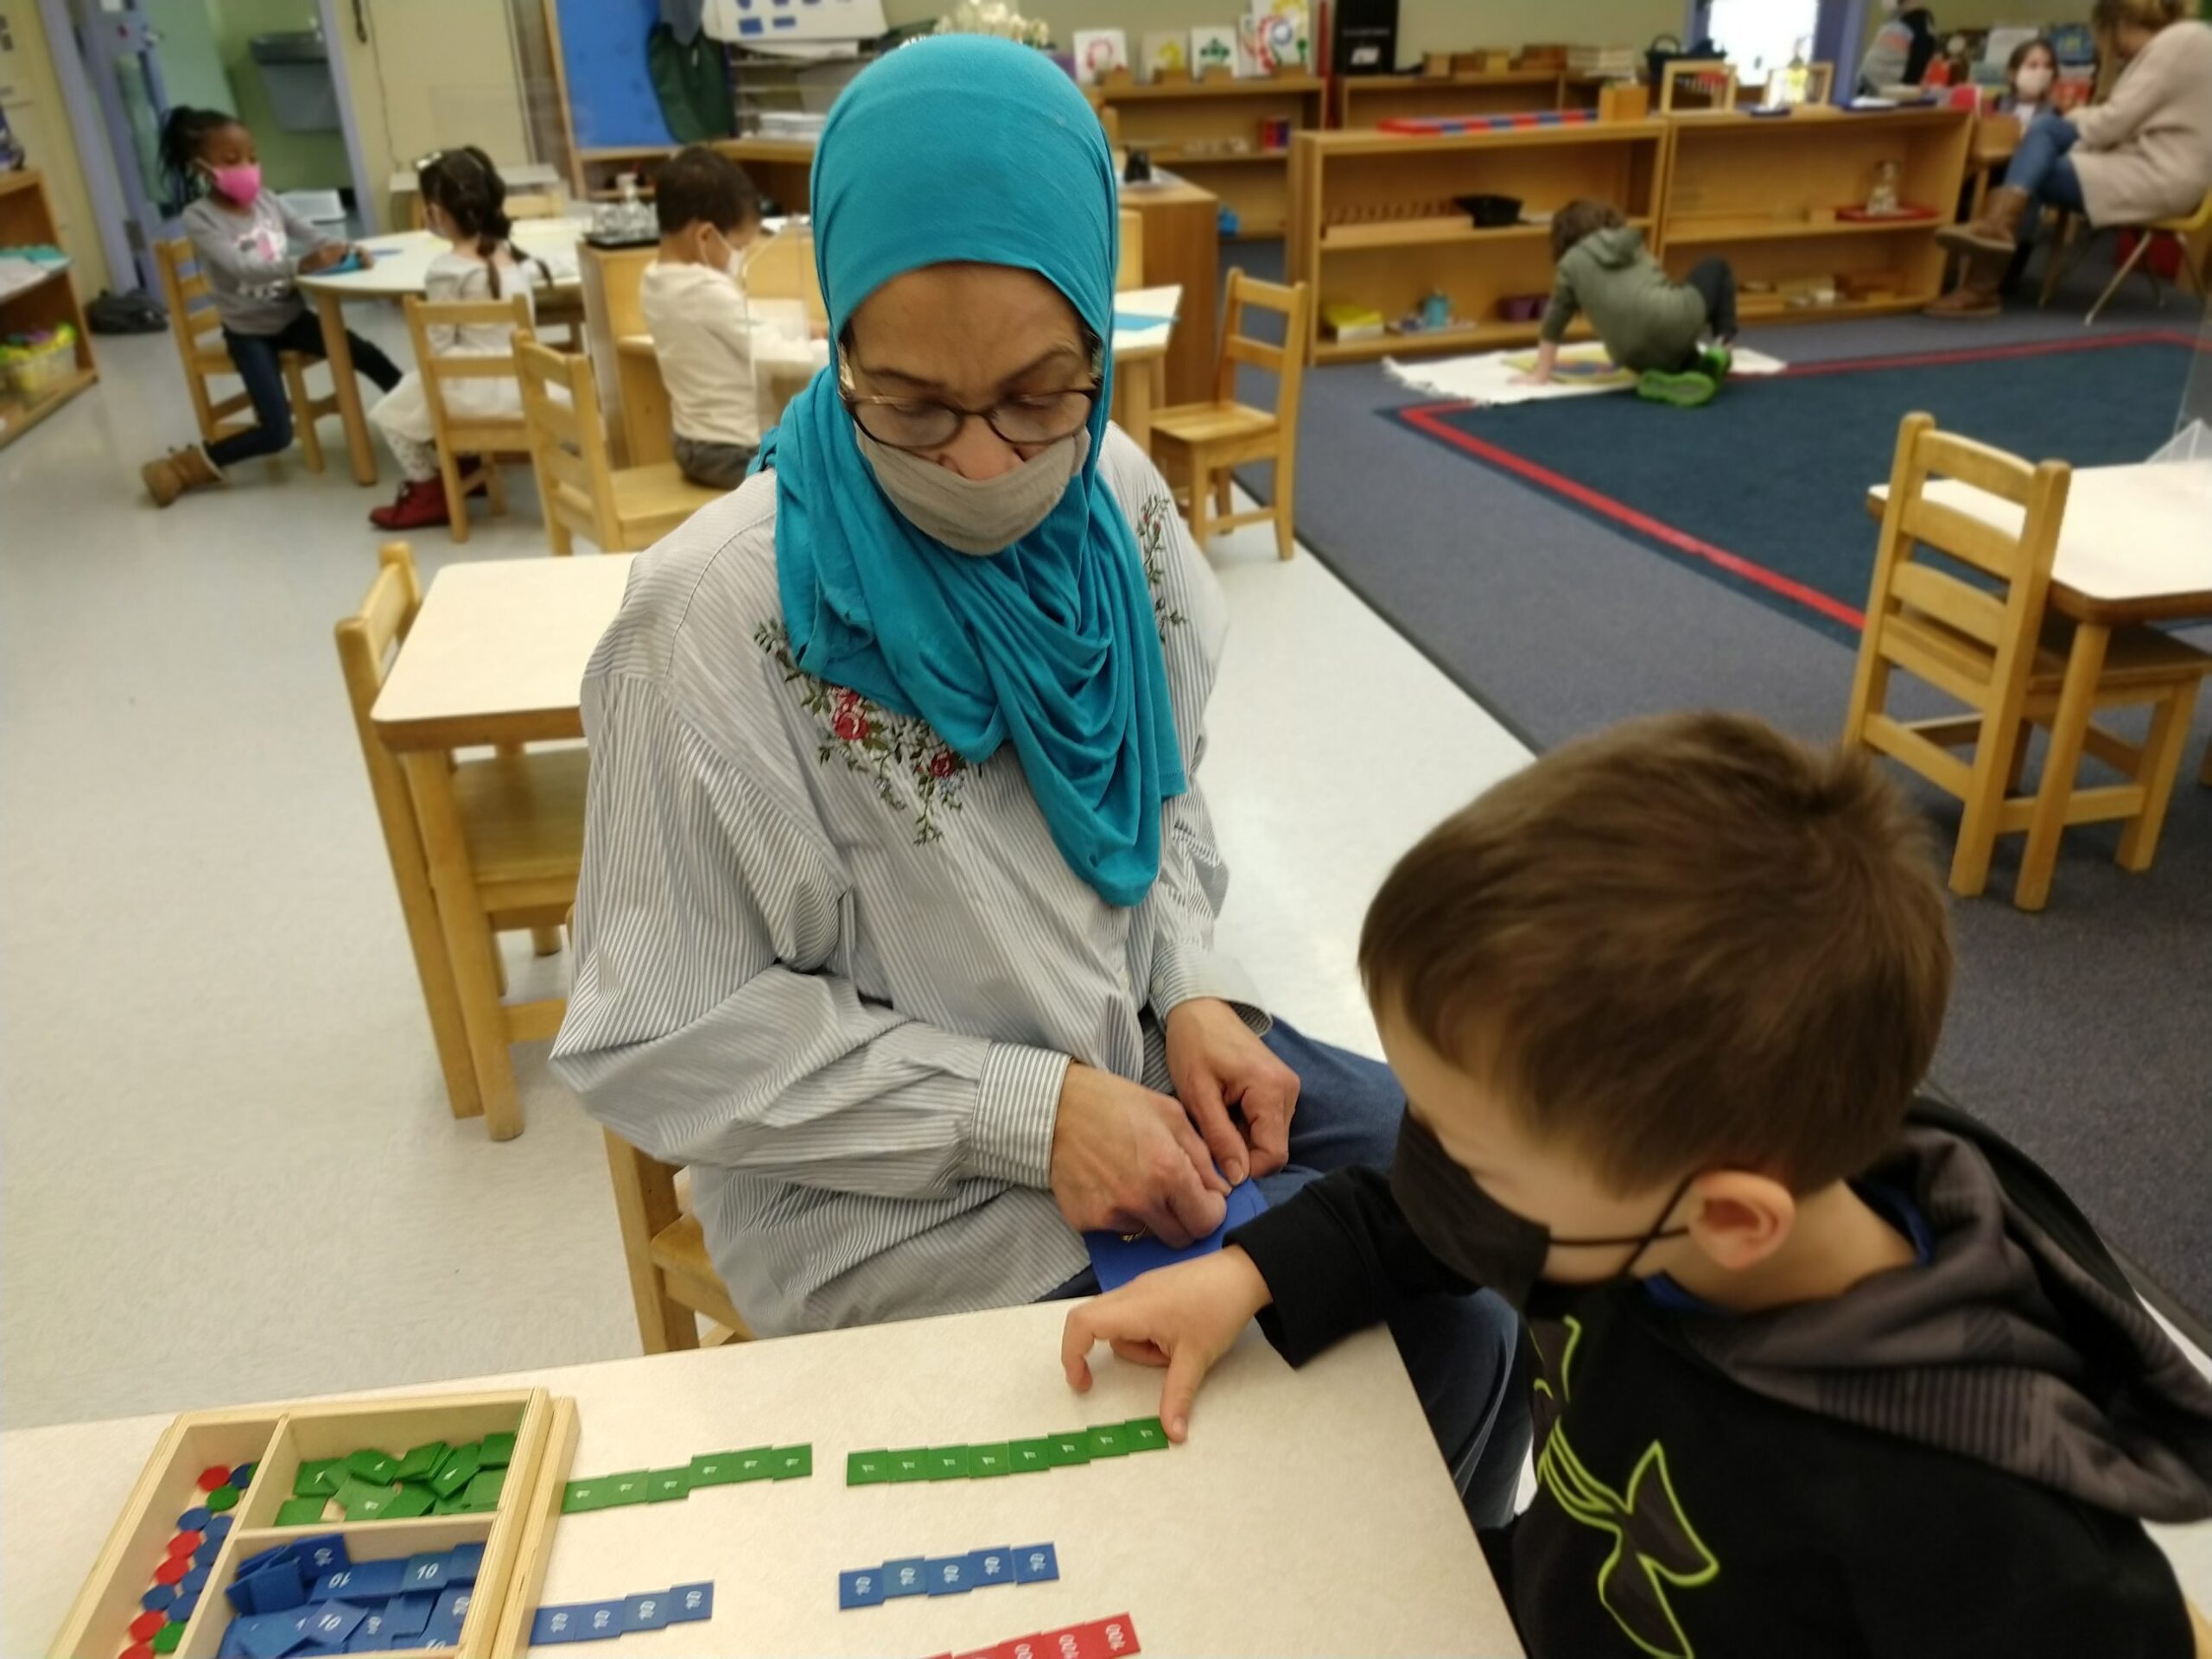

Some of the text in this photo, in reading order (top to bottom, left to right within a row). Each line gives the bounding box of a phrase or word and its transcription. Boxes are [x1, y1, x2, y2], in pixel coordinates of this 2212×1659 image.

[1099, 1436, 1114, 1446] 1
[1140, 1429, 1154, 1439] 1
[1022, 1451, 1036, 1460] 1
[1061, 1444, 1075, 1453] 1
[861, 1464, 875, 1473] 1
[901, 1461, 915, 1471] 1
[982, 1456, 995, 1465] 1
[416, 1563, 439, 1580] 10
[984, 1556, 1001, 1575] 10
[1029, 1553, 1046, 1572] 10
[328, 1572, 351, 1589] 10
[899, 1567, 916, 1586] 10
[943, 1565, 960, 1584] 10
[855, 1576, 872, 1596] 10
[685, 1590, 702, 1610] 10
[639, 1600, 656, 1620] 10
[318, 1613, 342, 1631] 10
[550, 1612, 569, 1633] 10
[593, 1610, 611, 1630] 10
[1105, 1624, 1126, 1651] 100
